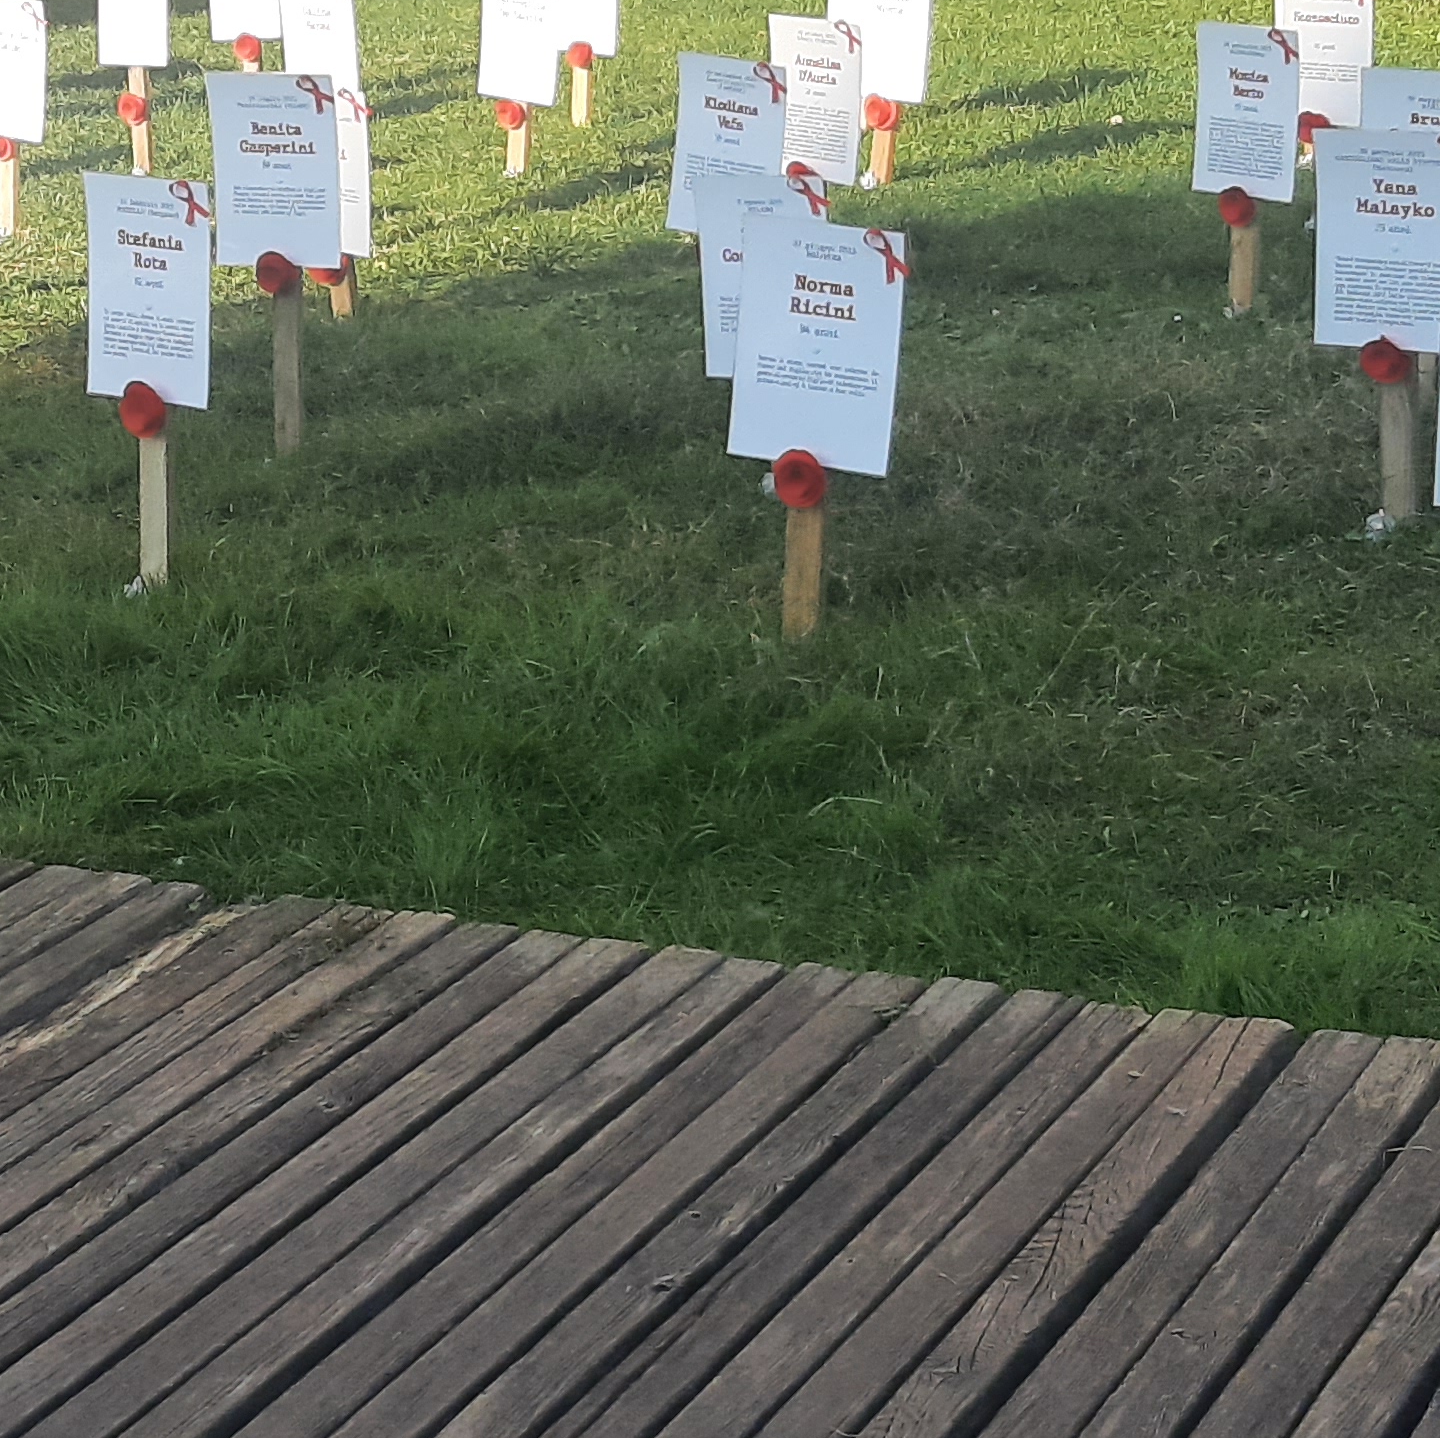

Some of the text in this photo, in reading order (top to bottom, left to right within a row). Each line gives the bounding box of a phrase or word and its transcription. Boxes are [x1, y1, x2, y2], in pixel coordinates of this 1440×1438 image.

[1228, 66, 1269, 84] Monica
[249, 121, 303, 137] Benita
[238, 139, 317, 157] Gasperini
[1372, 178, 1418, 196] Yana
[1355, 197, 1436, 220] Malayko
[117, 228, 184, 252] Stefania
[133, 251, 168, 271] Rota
[794, 273, 855, 298] Norma
[789, 296, 857, 322] Ricini
